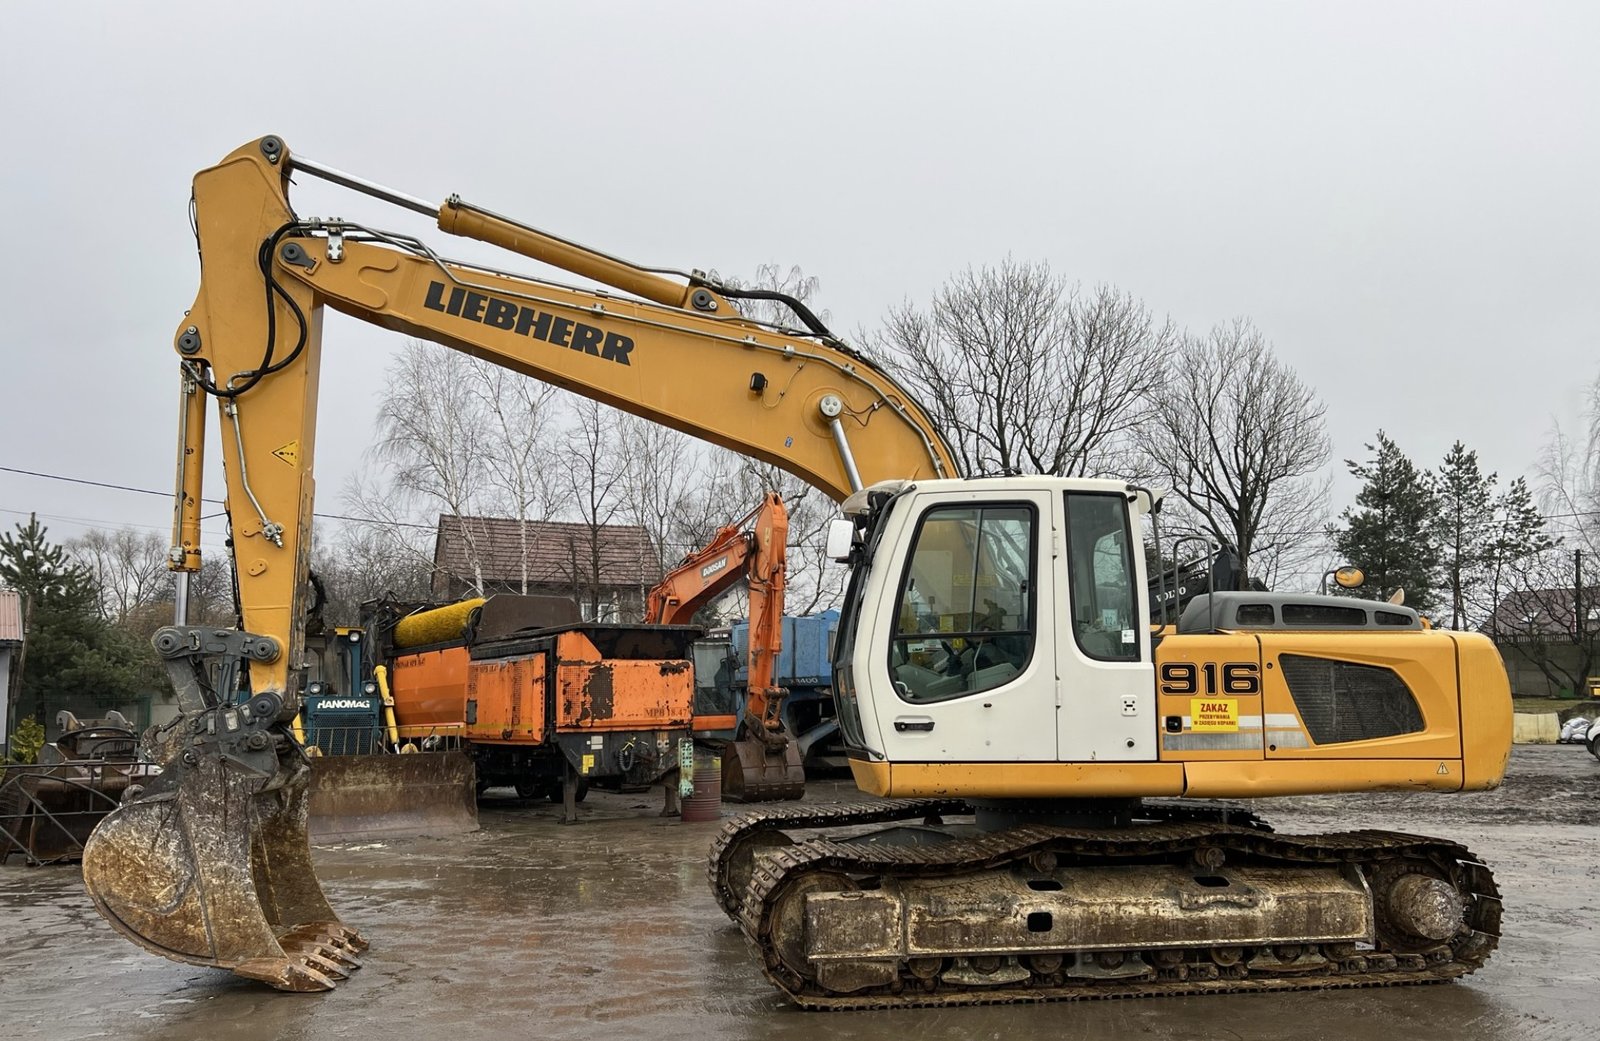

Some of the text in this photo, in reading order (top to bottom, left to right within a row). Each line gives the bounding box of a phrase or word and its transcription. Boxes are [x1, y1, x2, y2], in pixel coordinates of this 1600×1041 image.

[424, 280, 634, 366] LIEBHERR
[1156, 586, 1187, 602] VOLO
[1160, 662, 1260, 696] 916
[317, 700, 370, 709] HANOMAG
[1200, 703, 1228, 713] ZAKAZ
